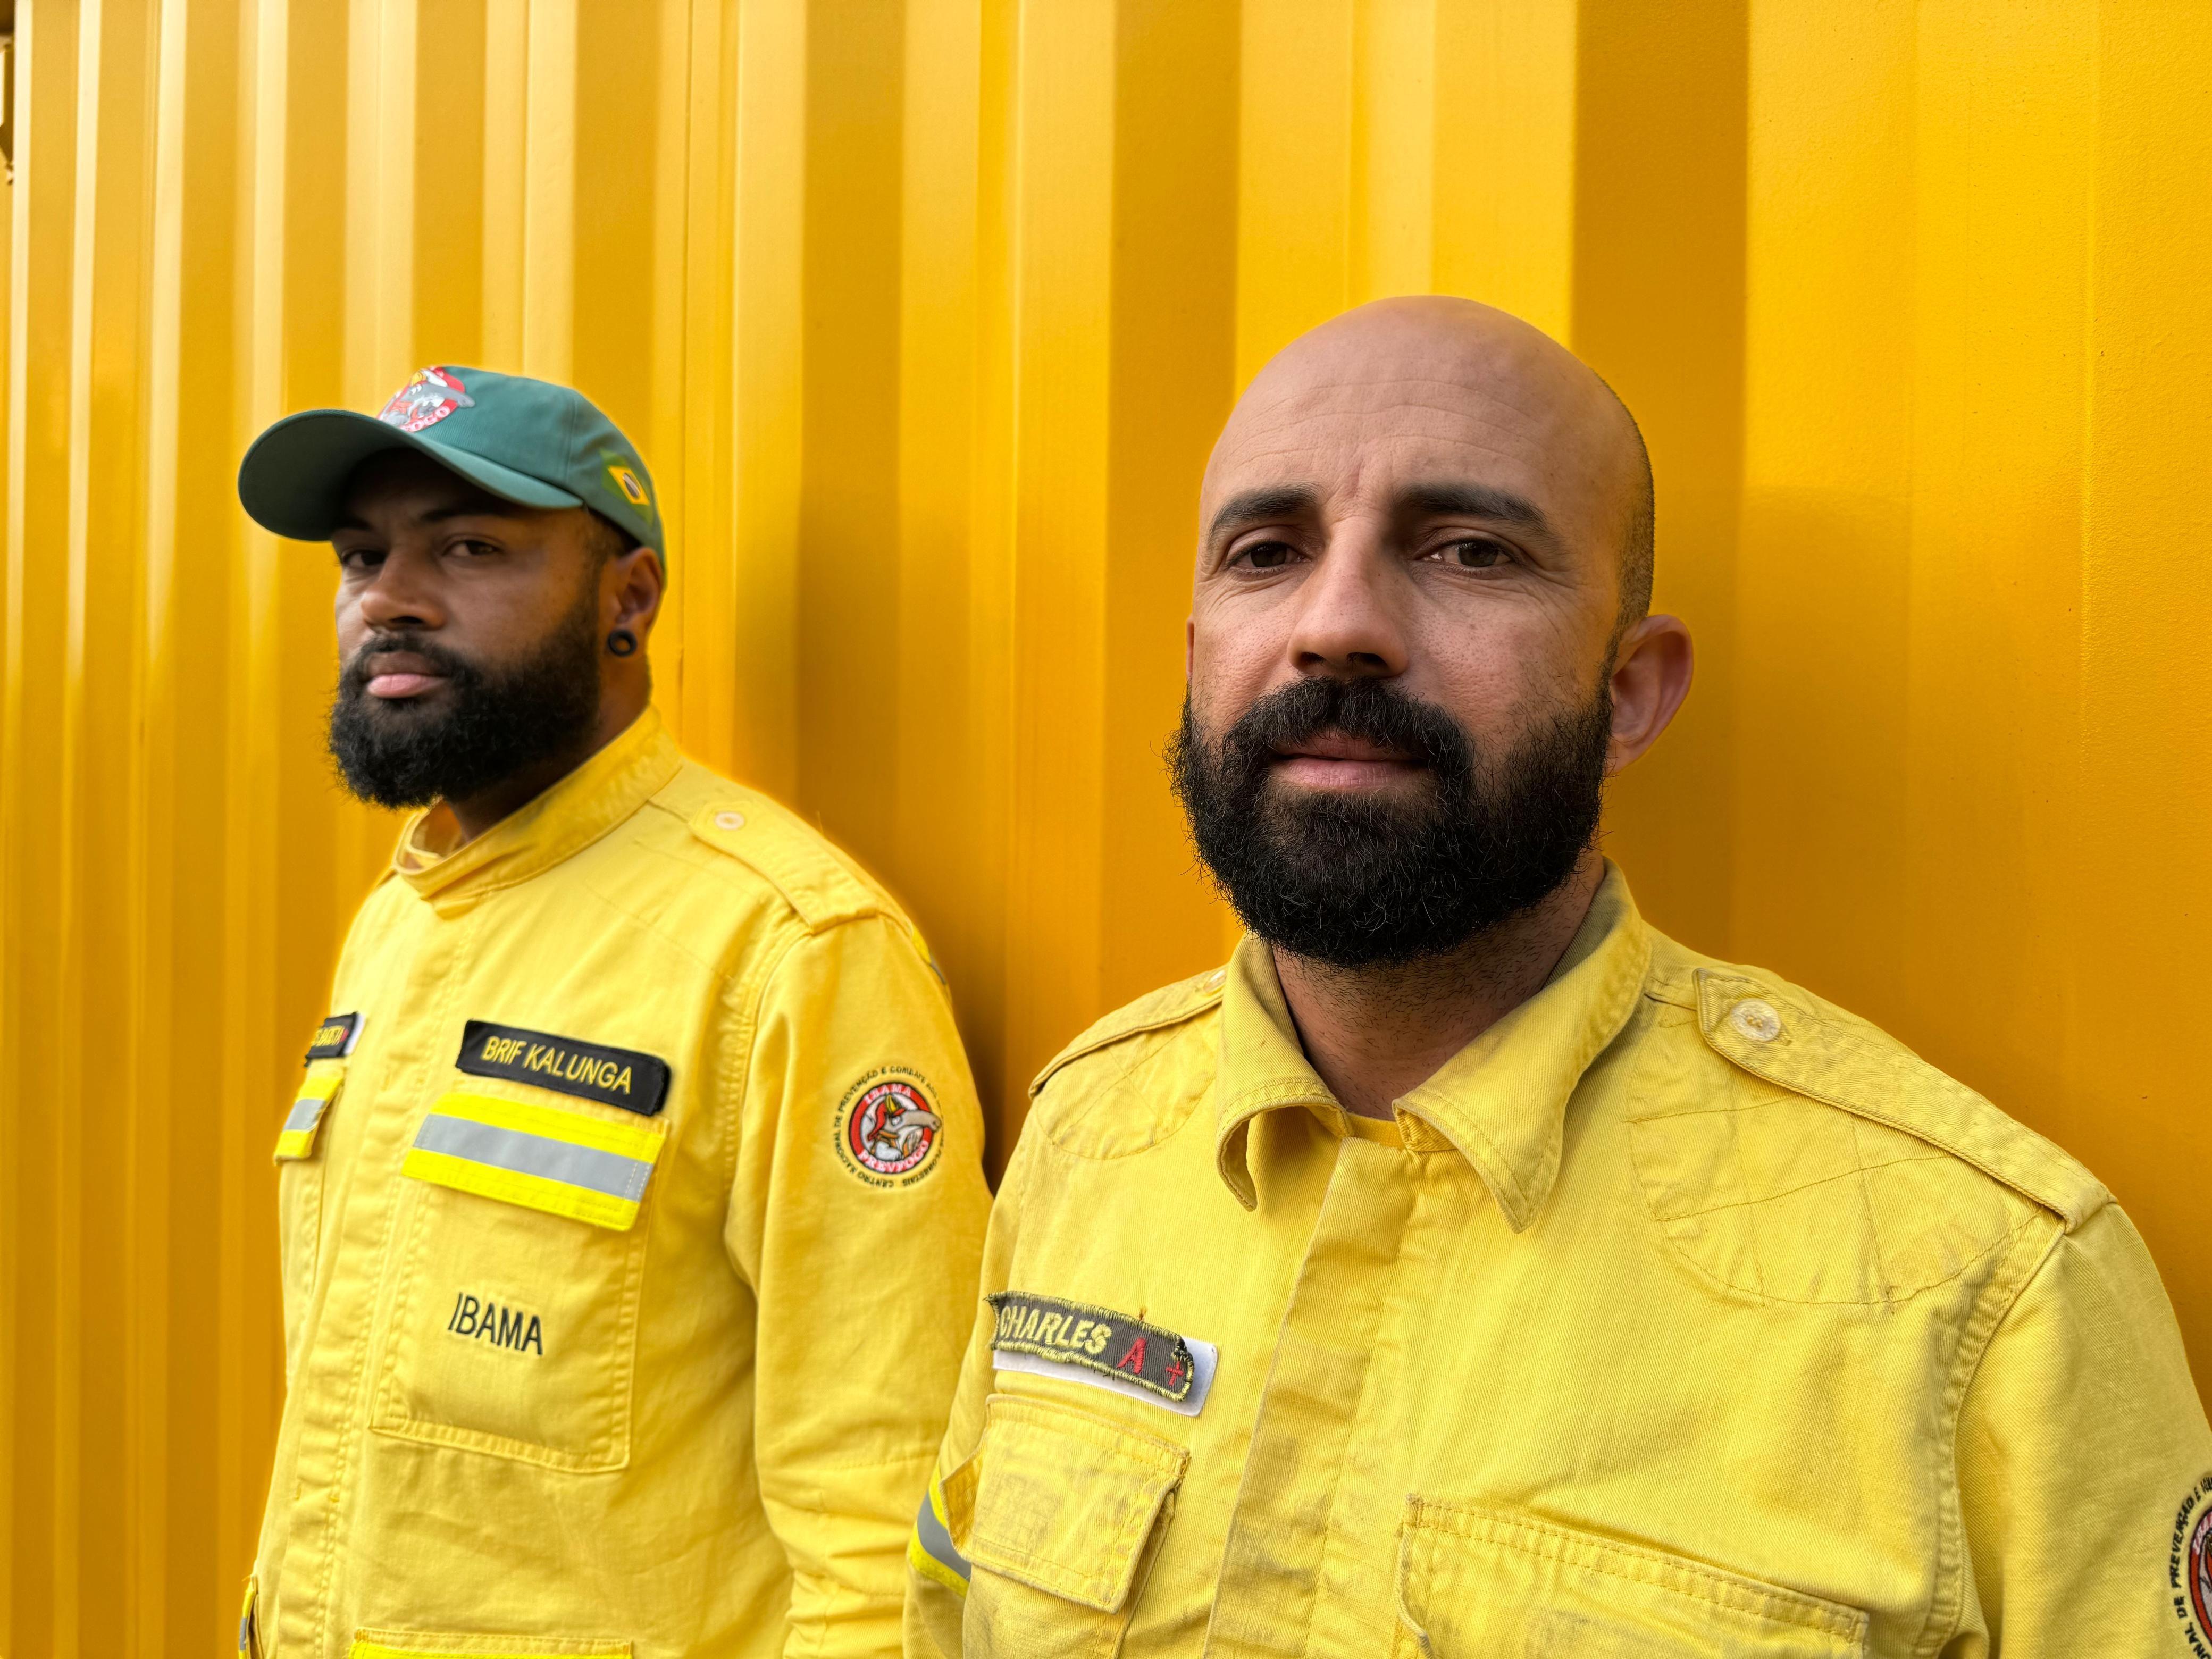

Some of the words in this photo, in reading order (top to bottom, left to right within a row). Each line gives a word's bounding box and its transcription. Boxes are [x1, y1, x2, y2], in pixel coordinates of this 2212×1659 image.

[481, 1035, 527, 1065] BRIF
[523, 1044, 633, 1095] KALUNGA
[863, 1083, 911, 1104] IBAMA
[858, 1140, 929, 1173] PREVFOGO
[448, 1292, 543, 1355] IBAMA
[998, 1305, 1112, 1354] CHARLES
[1117, 1337, 1147, 1375] A
[2174, 1596, 2188, 1619] DE
